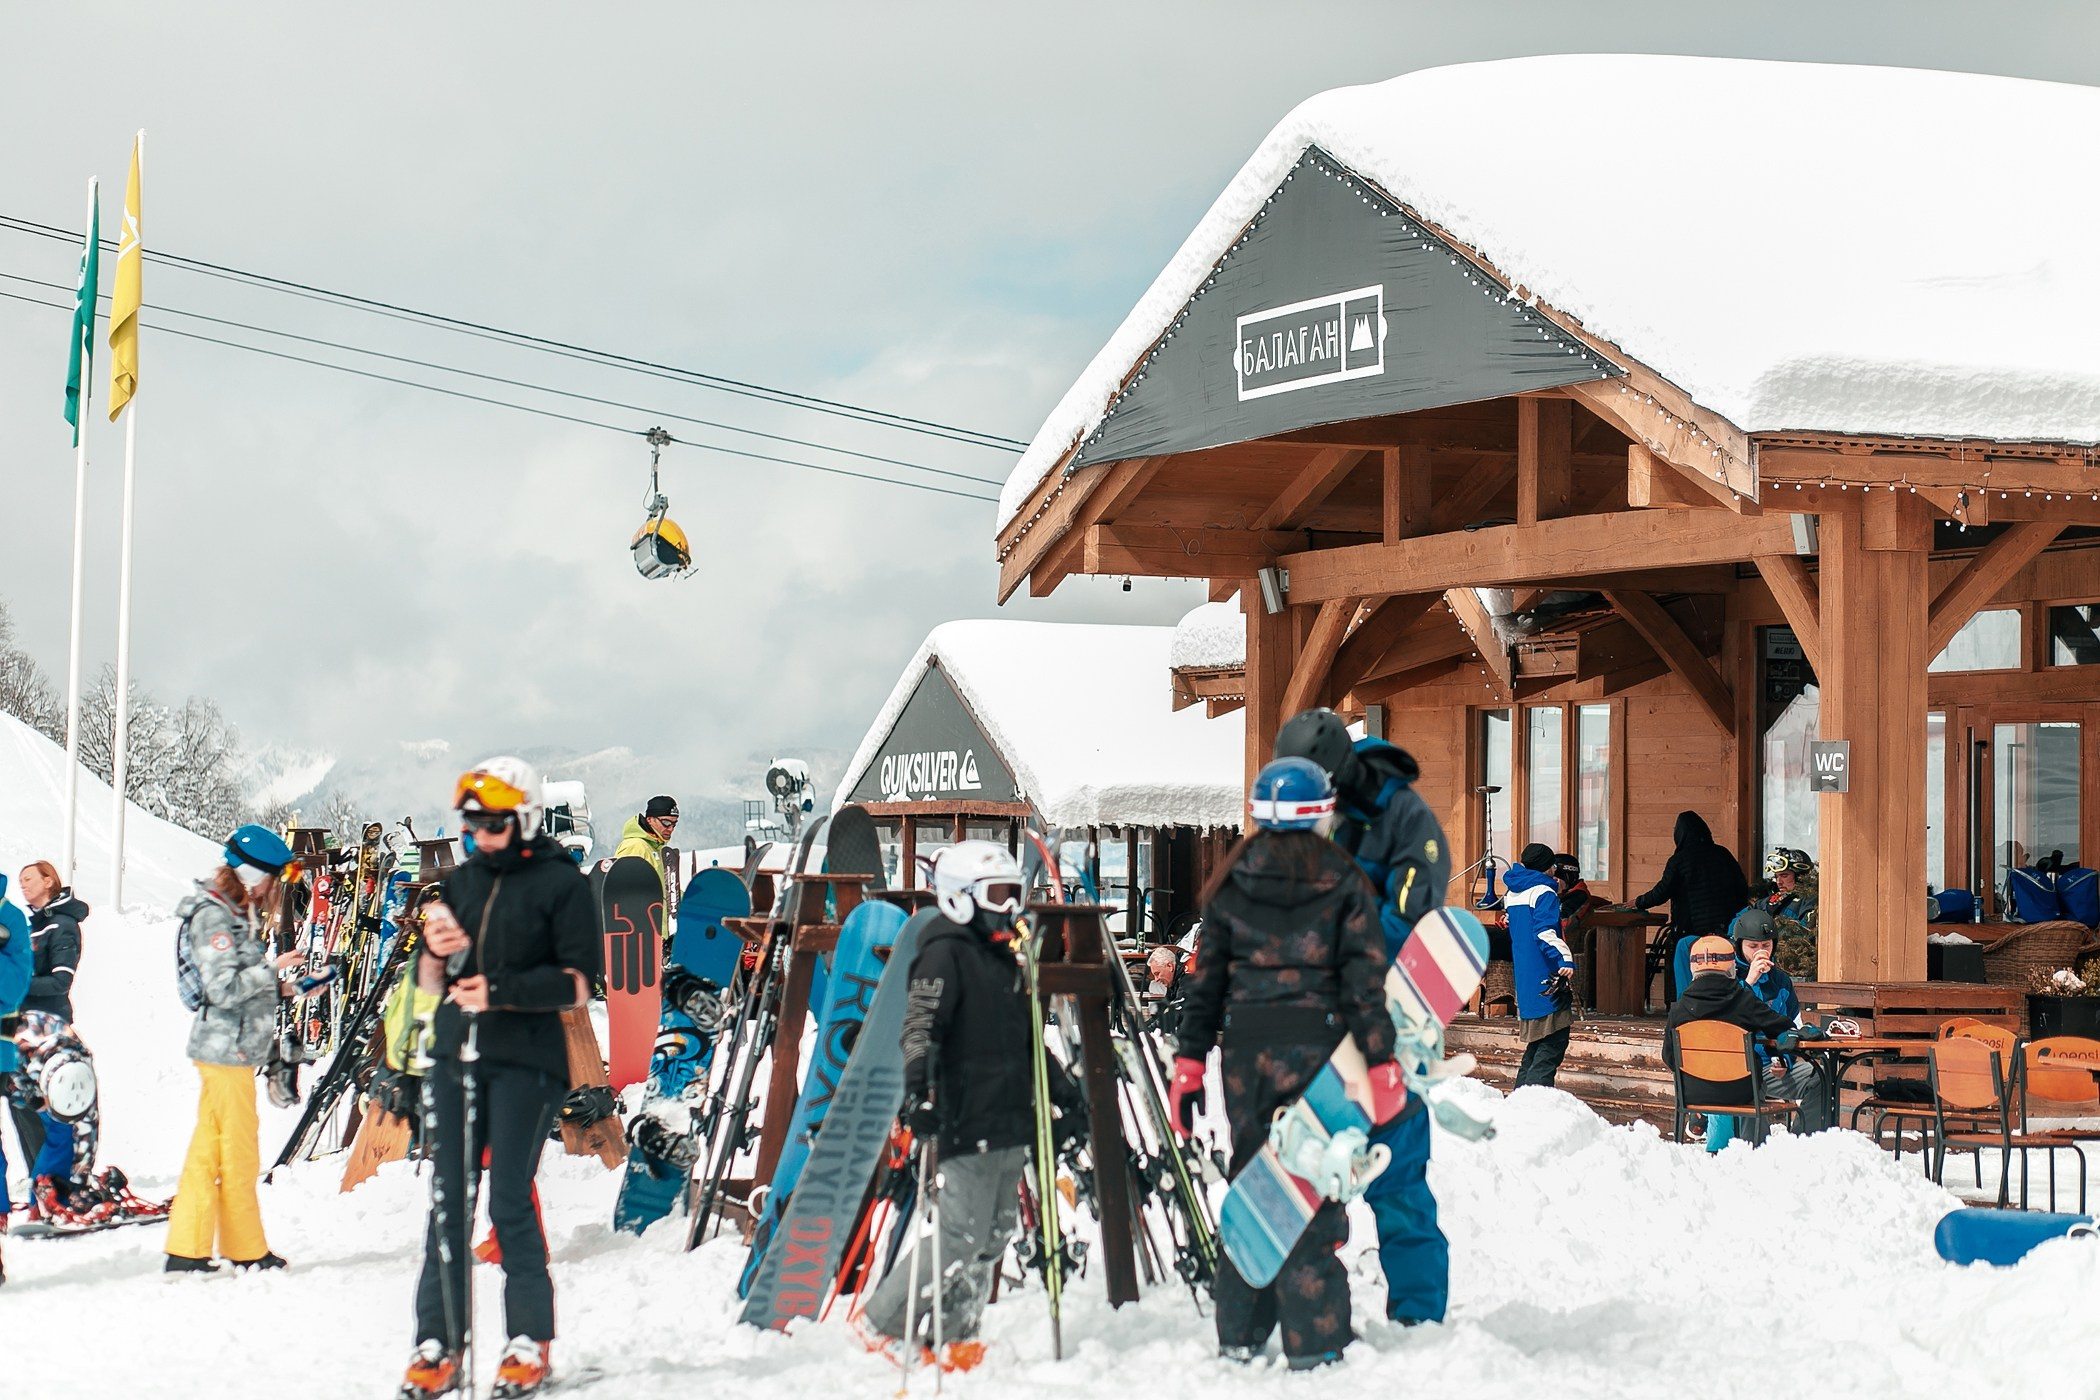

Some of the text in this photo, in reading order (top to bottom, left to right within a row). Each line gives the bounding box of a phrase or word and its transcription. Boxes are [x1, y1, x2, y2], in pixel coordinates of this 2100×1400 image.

[1243, 320, 1338, 376] БАЛАГАН
[880, 751, 958, 794] QUIKSILVER
[1815, 752, 1844, 772] WC
[771, 1216, 833, 1334] OXYG
